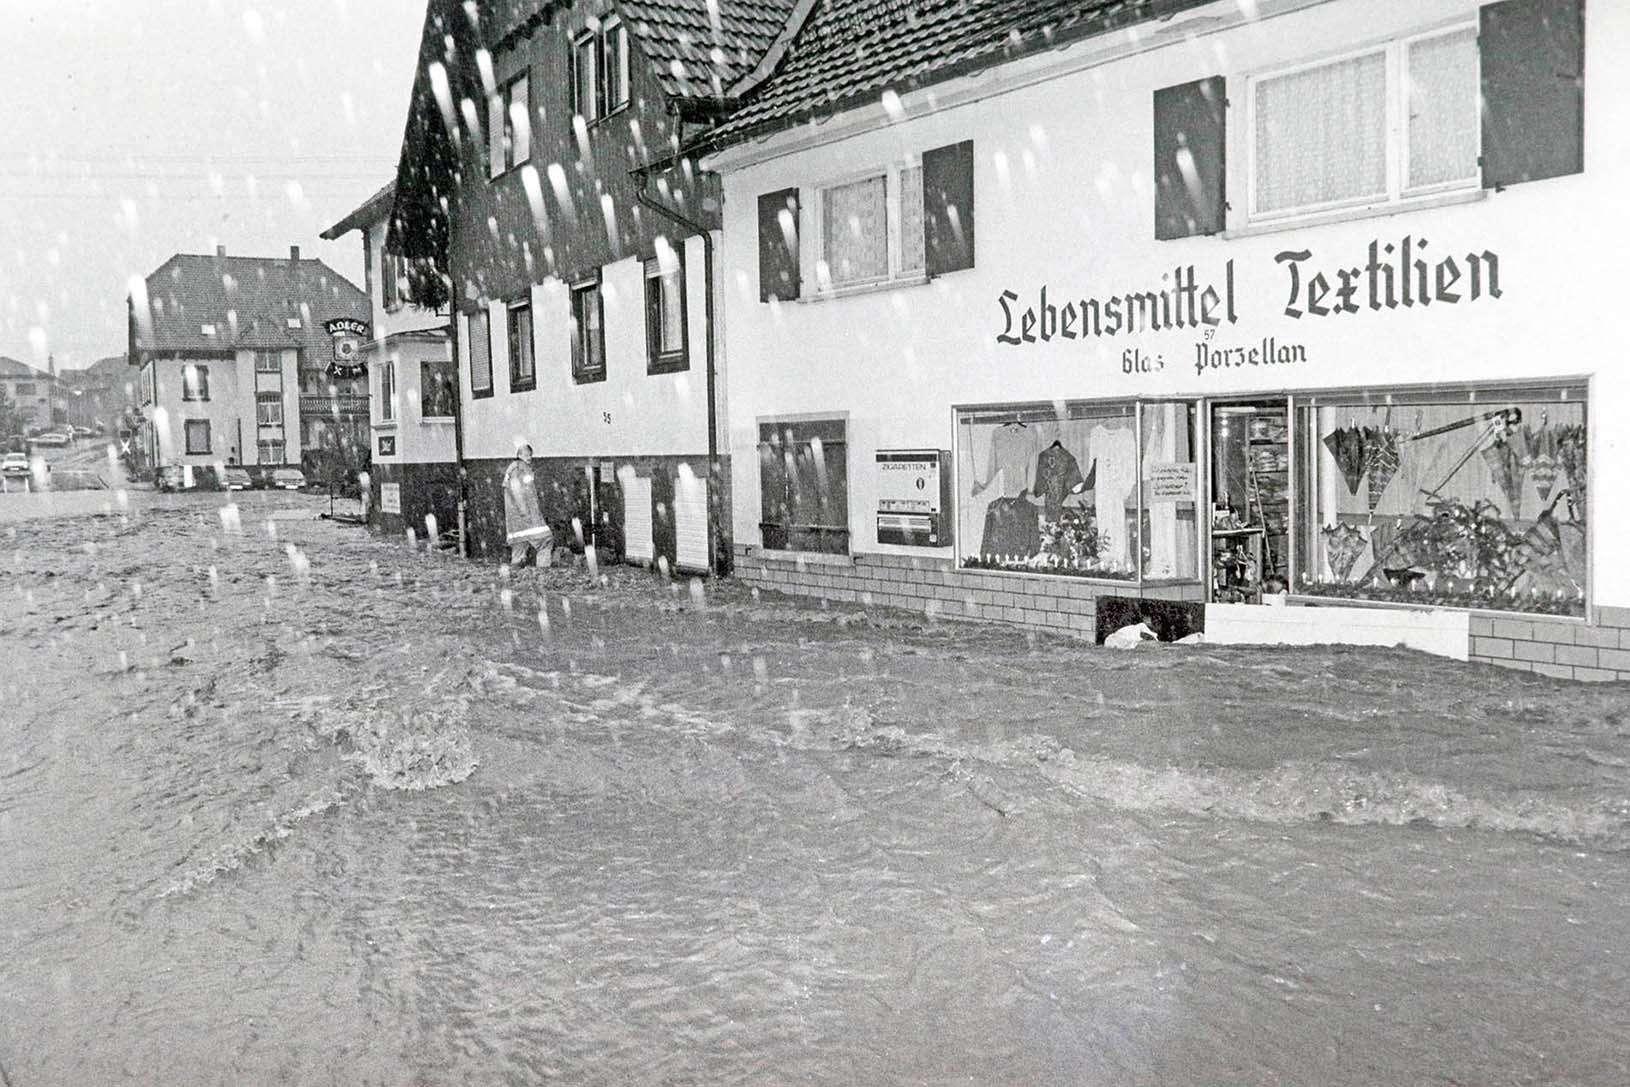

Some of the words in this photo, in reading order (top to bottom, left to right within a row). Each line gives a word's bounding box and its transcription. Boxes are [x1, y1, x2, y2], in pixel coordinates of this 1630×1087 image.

[996, 258, 1238, 346] Lebensmittel
[1275, 235, 1503, 319] Textilien
[329, 321, 365, 333] ADLER
[1203, 329, 1216, 341] 57
[1122, 348, 1164, 374] Glas
[1194, 336, 1307, 376] Porzellan
